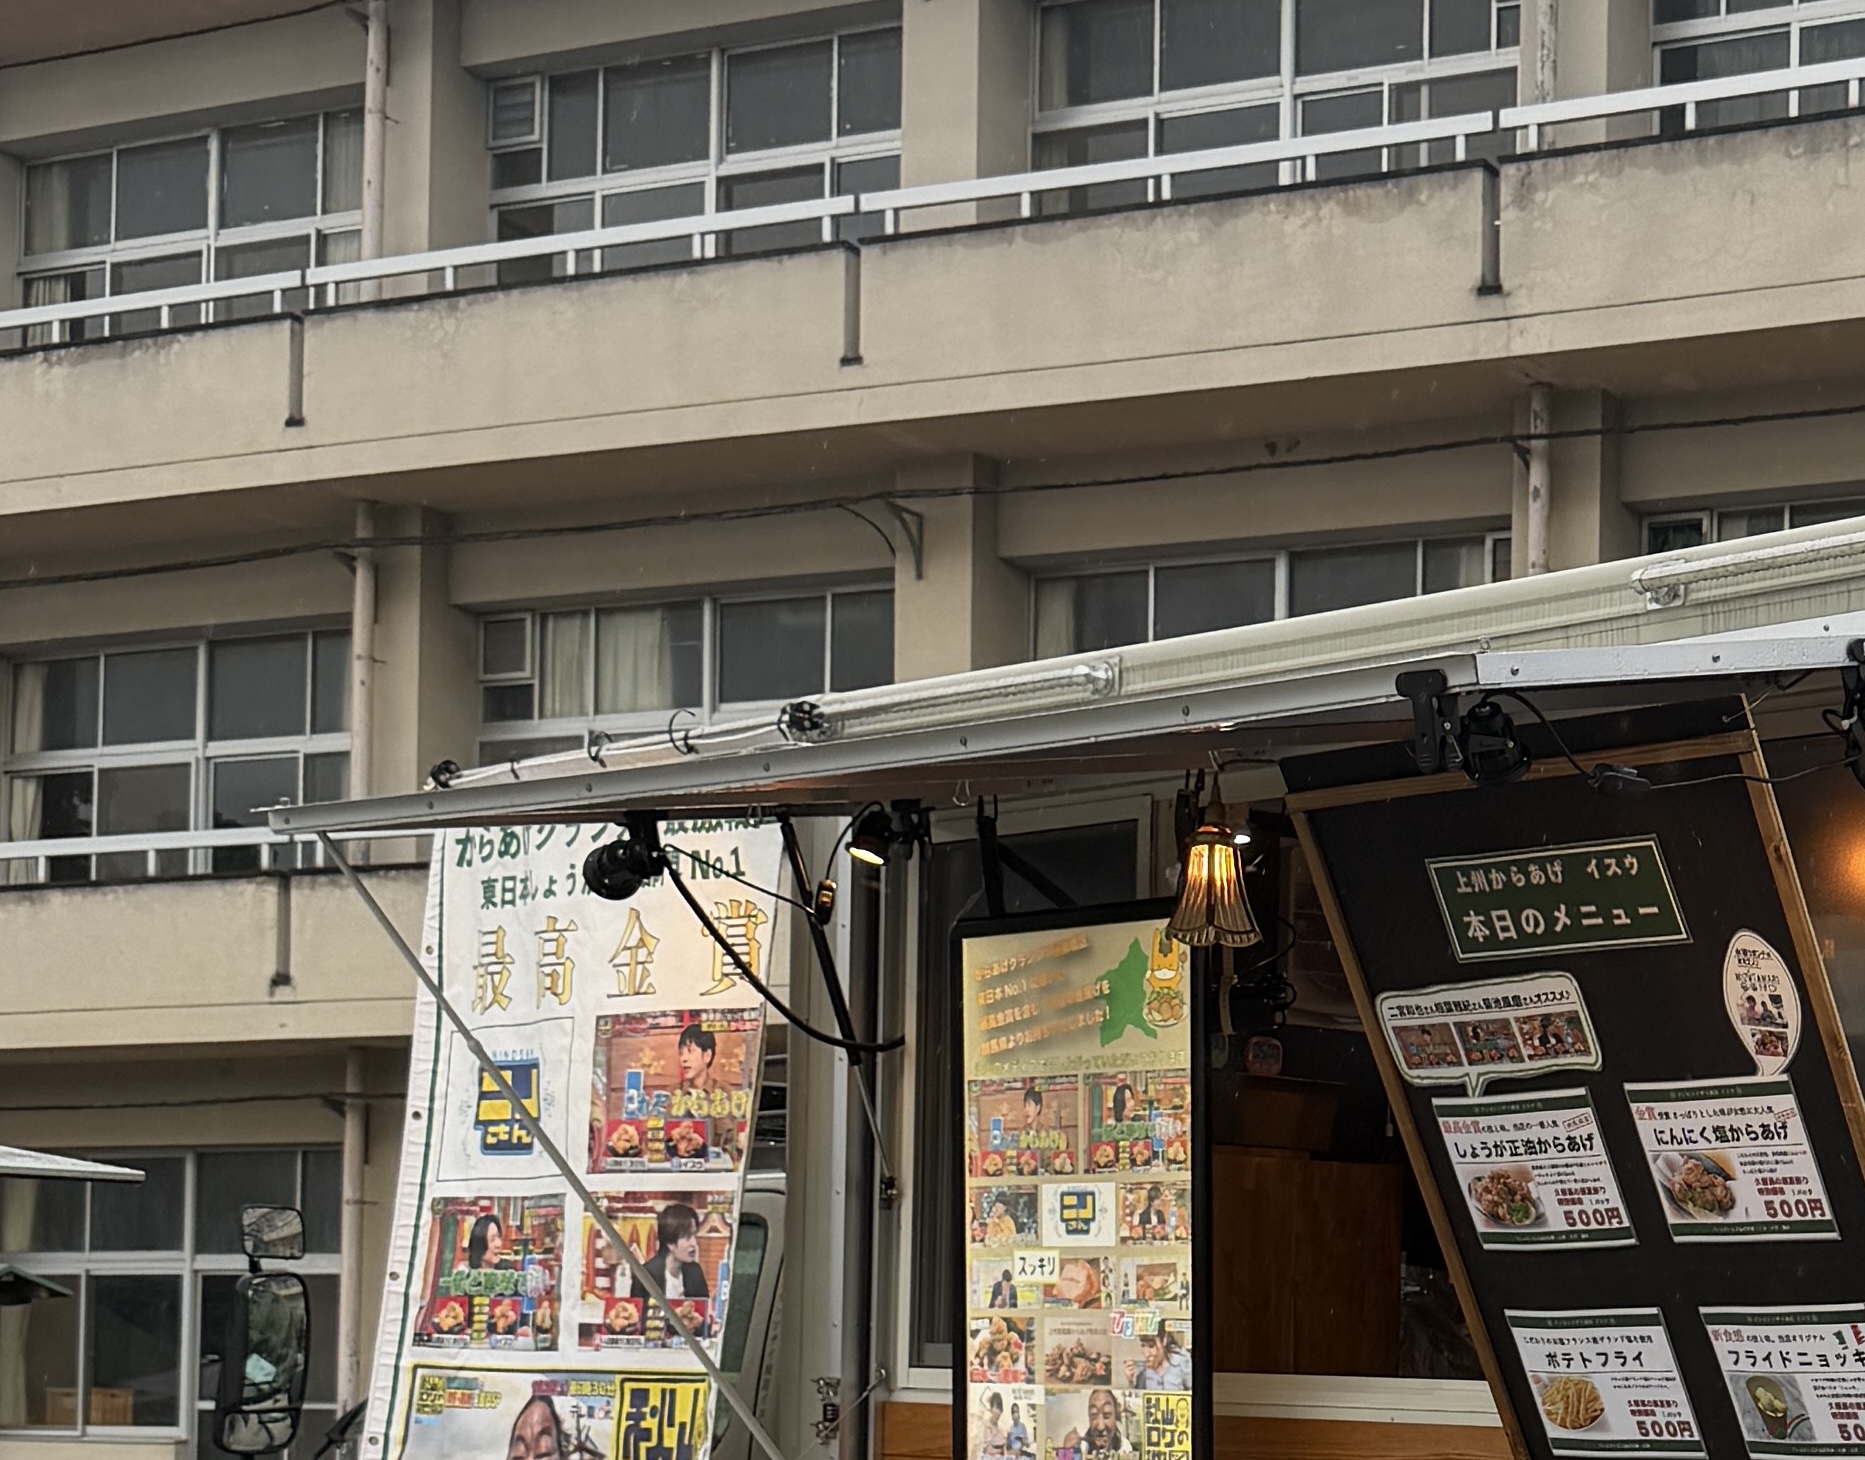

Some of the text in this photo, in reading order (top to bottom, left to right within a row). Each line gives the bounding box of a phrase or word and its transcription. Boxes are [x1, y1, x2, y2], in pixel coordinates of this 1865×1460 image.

[1456, 854, 1639, 893] 上州からあげ イスウ
[1463, 903, 1659, 942] 本日のメニュー
[471, 899, 768, 1014] 最高金賞
[1654, 1121, 1788, 1145] にんにく塩からあげ
[1454, 1133, 1594, 1158] しょうが正油からあげ
[1563, 1207, 1624, 1227] 500円
[1764, 1198, 1826, 1218] 500円
[1545, 1351, 1644, 1369] ポテトフライ
[1636, 1420, 1695, 1438] 500円
